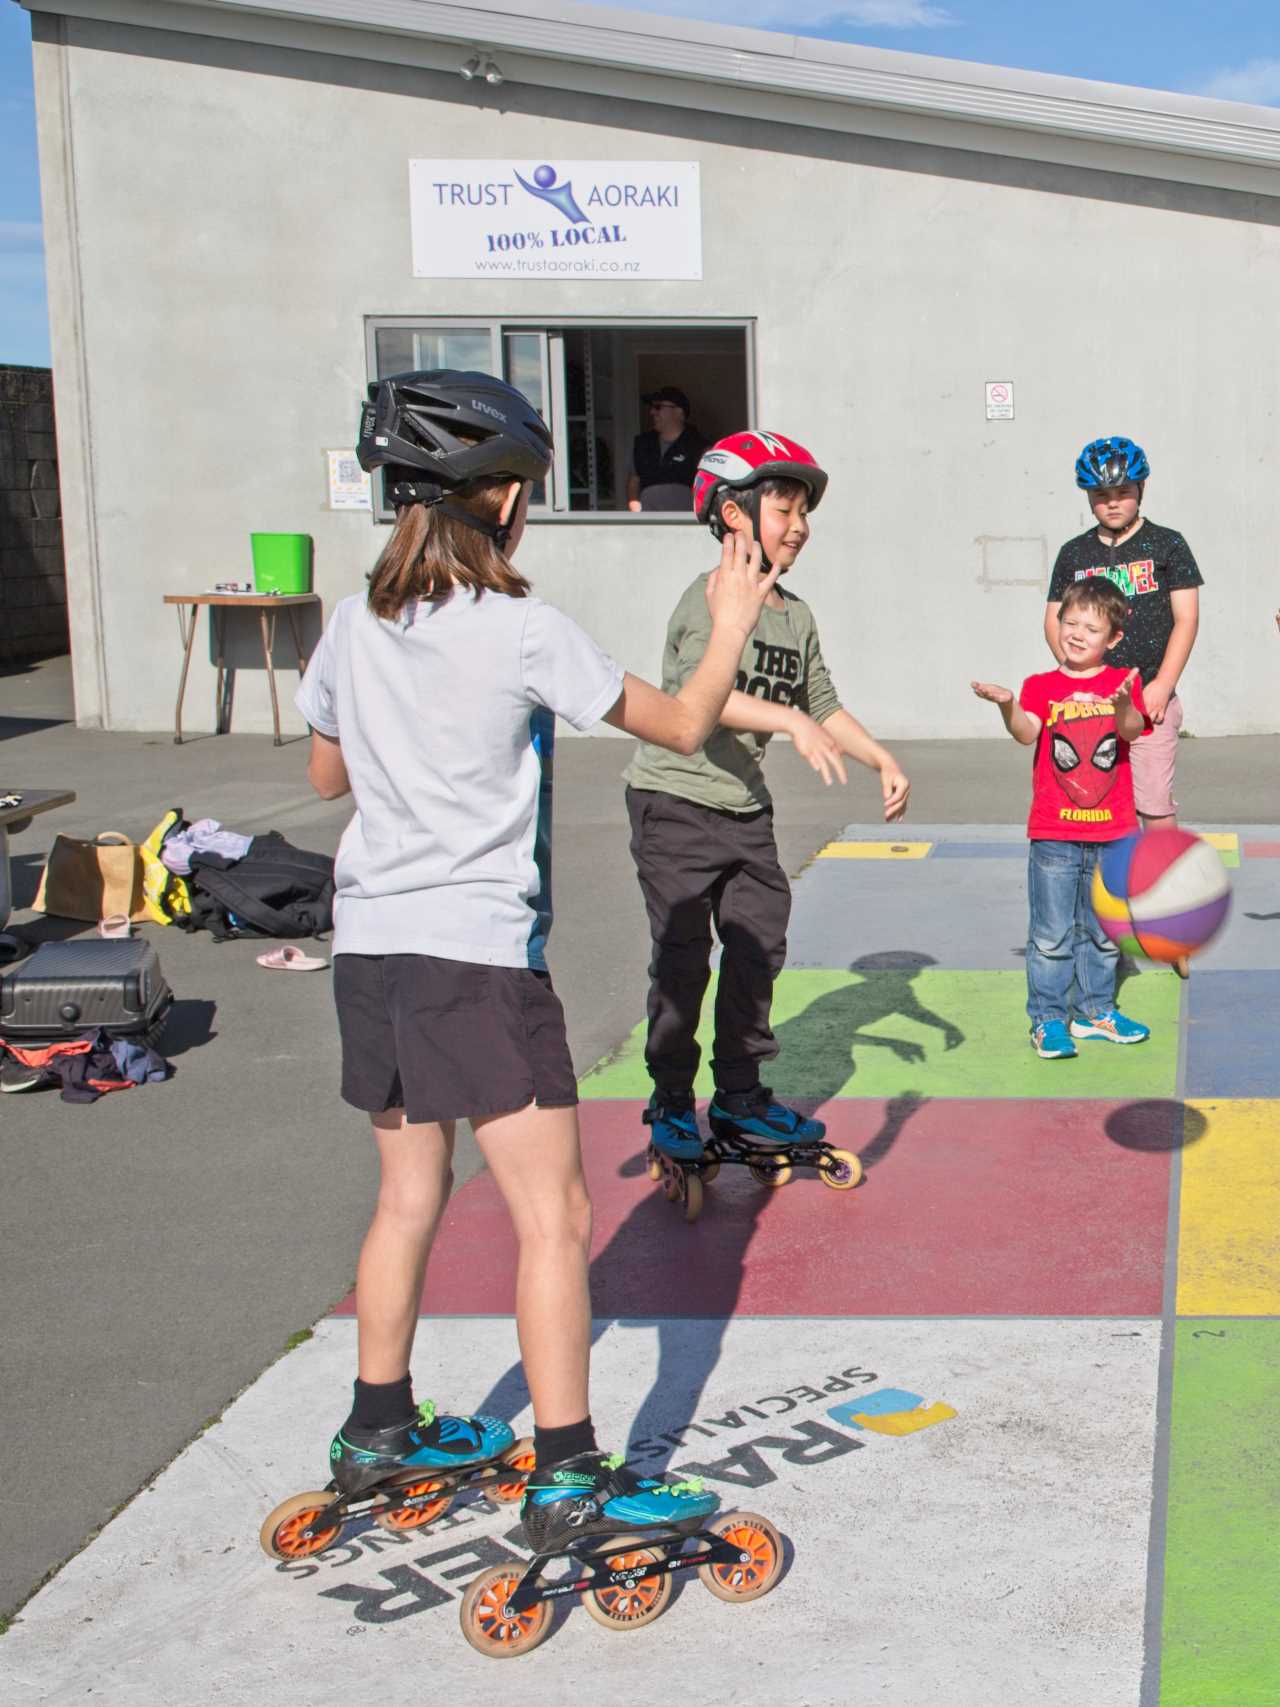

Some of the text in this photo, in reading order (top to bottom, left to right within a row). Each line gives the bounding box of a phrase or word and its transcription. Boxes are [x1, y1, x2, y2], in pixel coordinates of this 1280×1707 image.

[432, 182, 679, 207] TRUST AORAKI
[486, 224, 627, 253] 100% LOCAL
[474, 258, 641, 273] www.trustaoraki.co.nz
[471, 399, 508, 424] uvex
[752, 639, 803, 685] THE
[1060, 808, 1112, 822] FLORIDA
